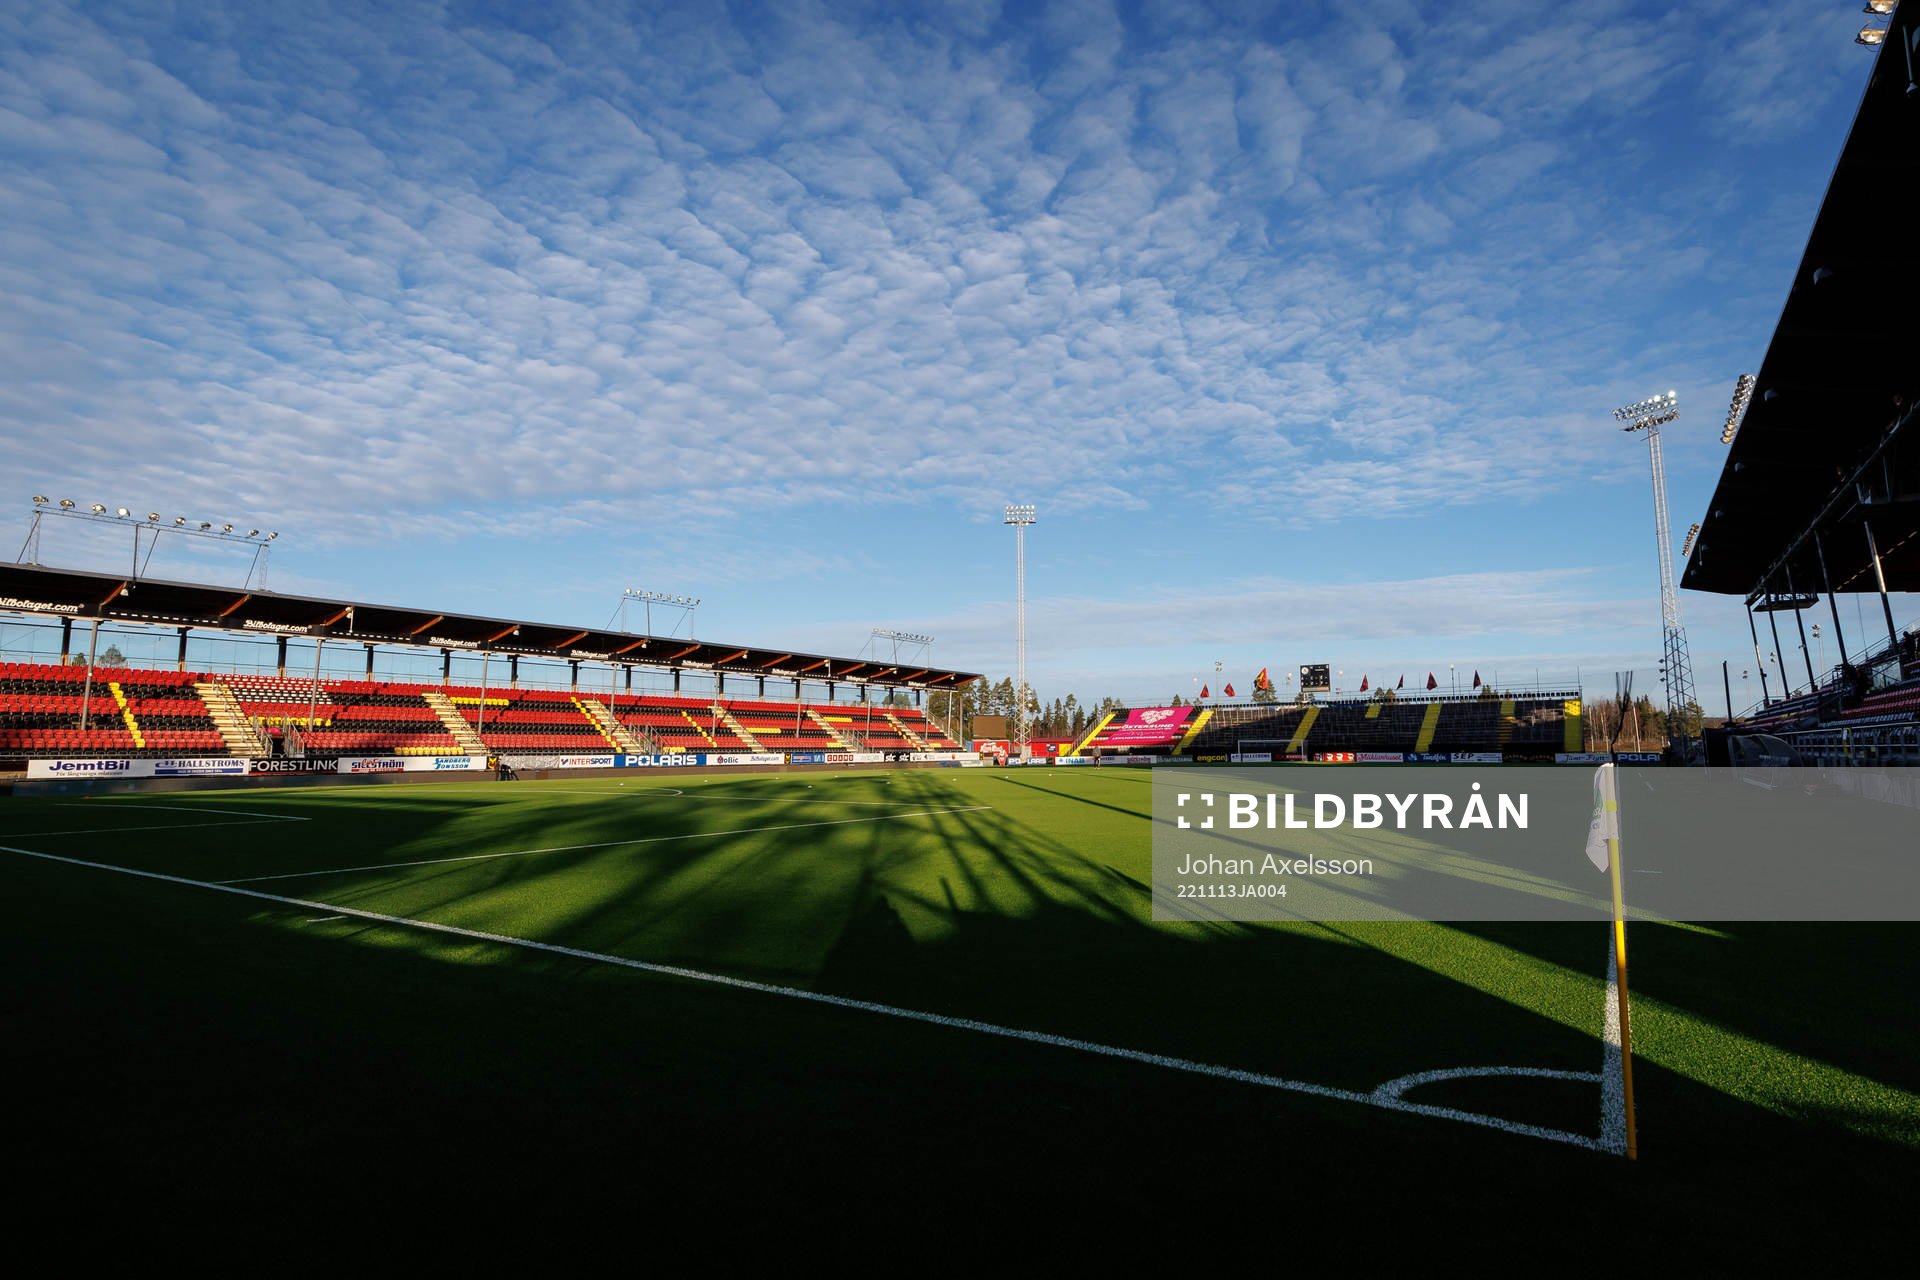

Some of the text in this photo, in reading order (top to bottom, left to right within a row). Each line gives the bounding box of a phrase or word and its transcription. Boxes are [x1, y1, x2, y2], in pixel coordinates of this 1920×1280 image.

[243, 620, 308, 633] Bilbolaget.com
[569, 757, 612, 767] INTERSPORT
[625, 755, 698, 766] POLARIS
[1197, 754, 1227, 762] engcon
[49, 760, 130, 771] JemtBil
[250, 759, 338, 772] FORESTLINK
